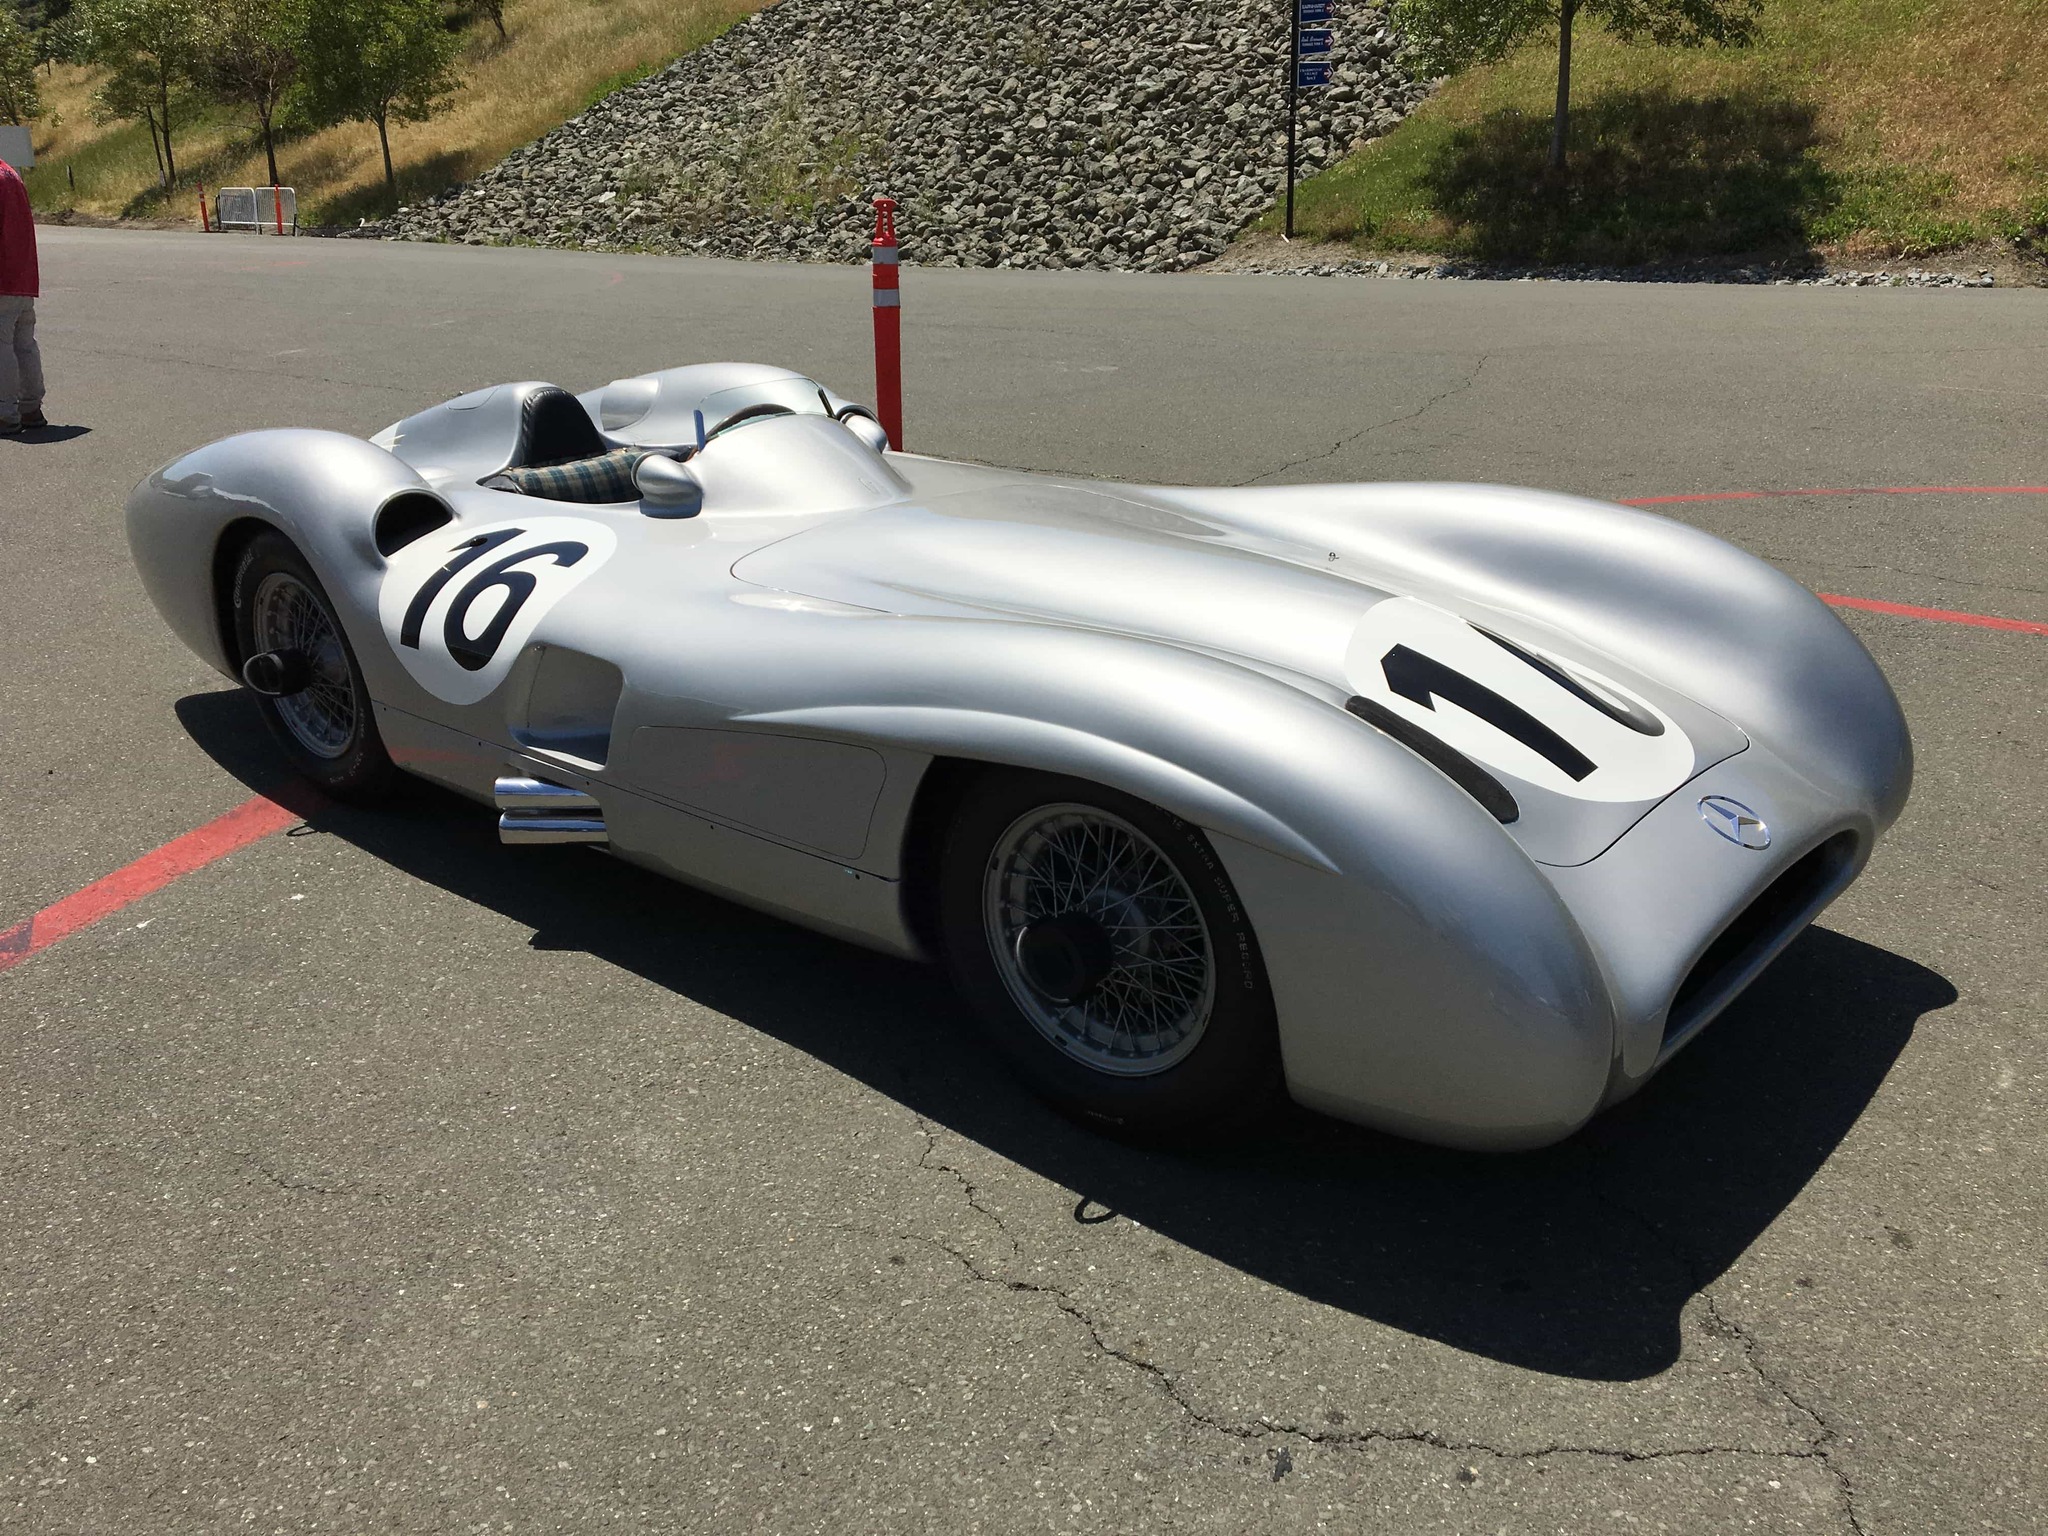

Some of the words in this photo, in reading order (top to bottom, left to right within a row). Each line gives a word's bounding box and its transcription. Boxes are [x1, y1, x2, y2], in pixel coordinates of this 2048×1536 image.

[400, 527, 590, 672] 16
[1213, 876, 1240, 923] SUPER
[1236, 931, 1254, 990] RECORD
